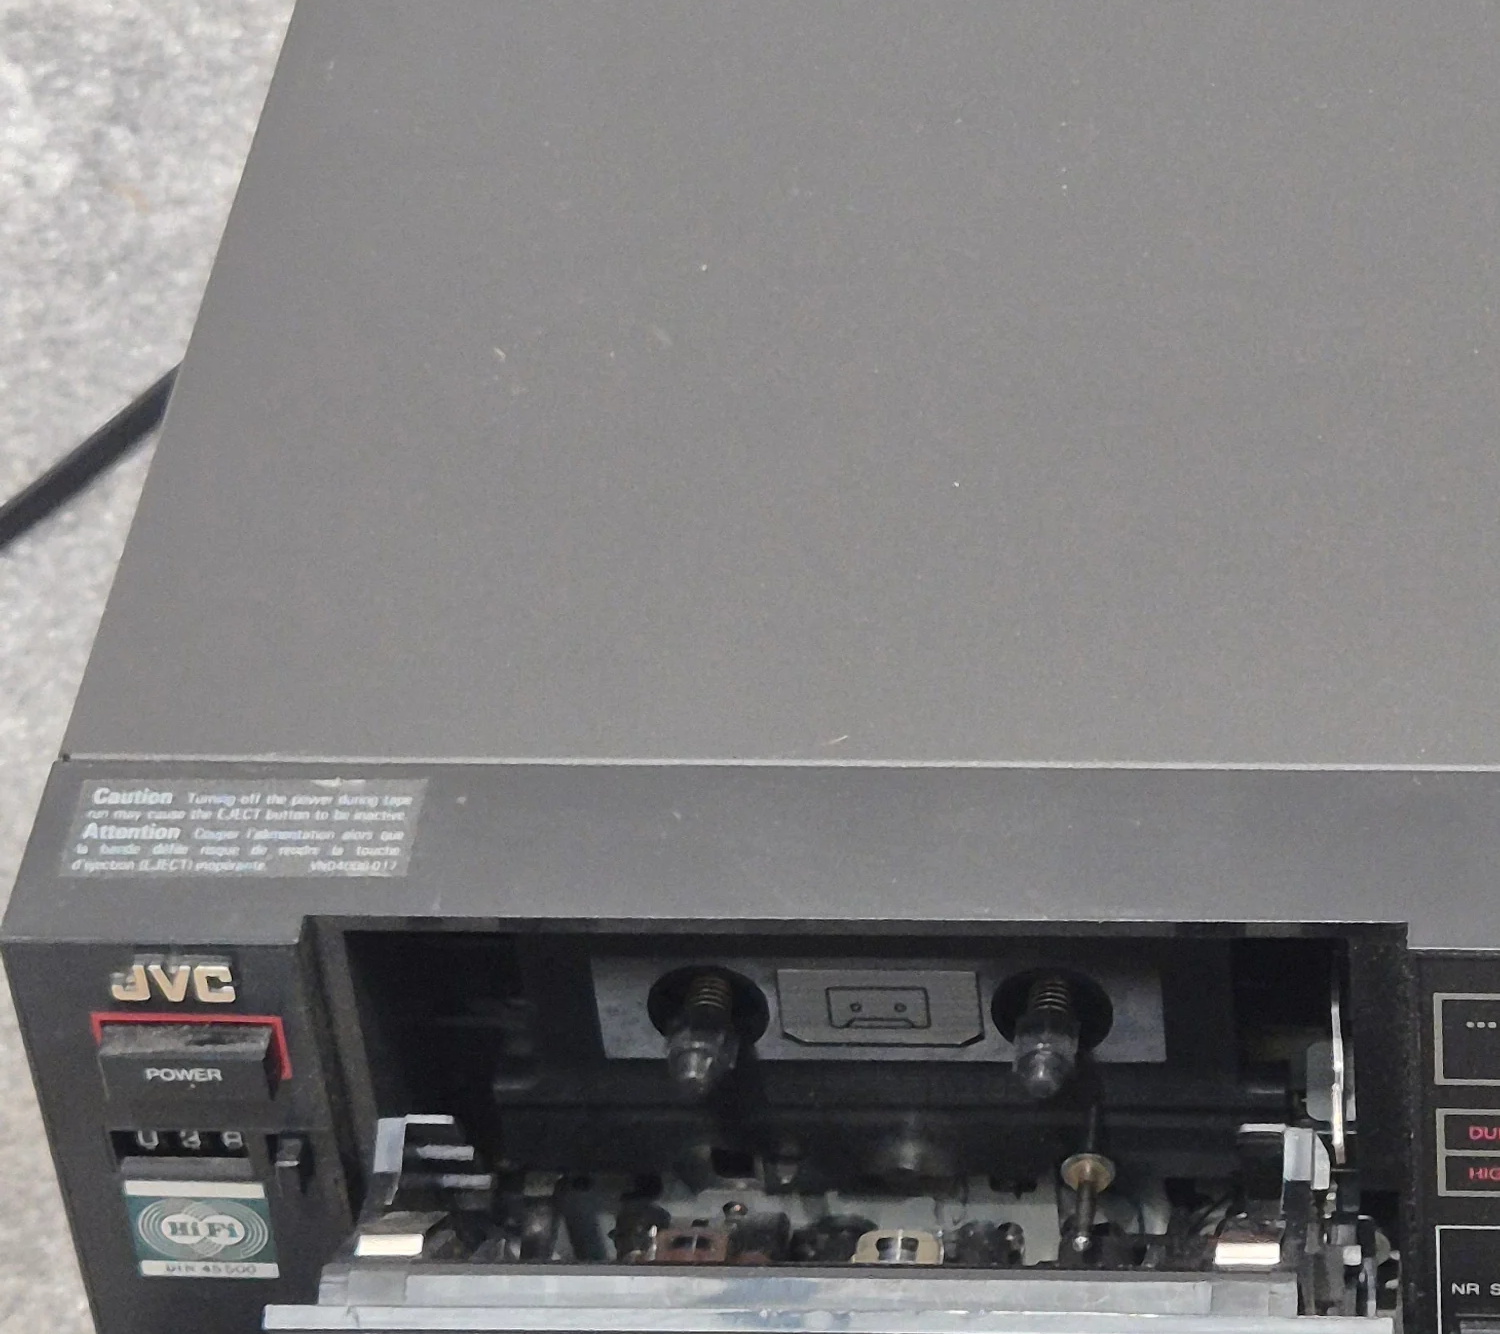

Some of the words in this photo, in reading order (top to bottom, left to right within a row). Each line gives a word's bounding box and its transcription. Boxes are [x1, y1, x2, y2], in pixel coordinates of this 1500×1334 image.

[93, 787, 173, 805] Caution
[188, 791, 236, 808] Turning
[239, 791, 261, 805] off
[265, 791, 287, 805] the
[290, 793, 333, 807] power
[338, 792, 378, 808] during
[190, 808, 213, 820] the
[265, 808, 310, 821] button
[314, 809, 330, 821] to
[82, 822, 181, 840] Attention
[111, 964, 236, 1003] JVC
[145, 1067, 223, 1082] POWER
[1451, 1282, 1481, 1297] NR
